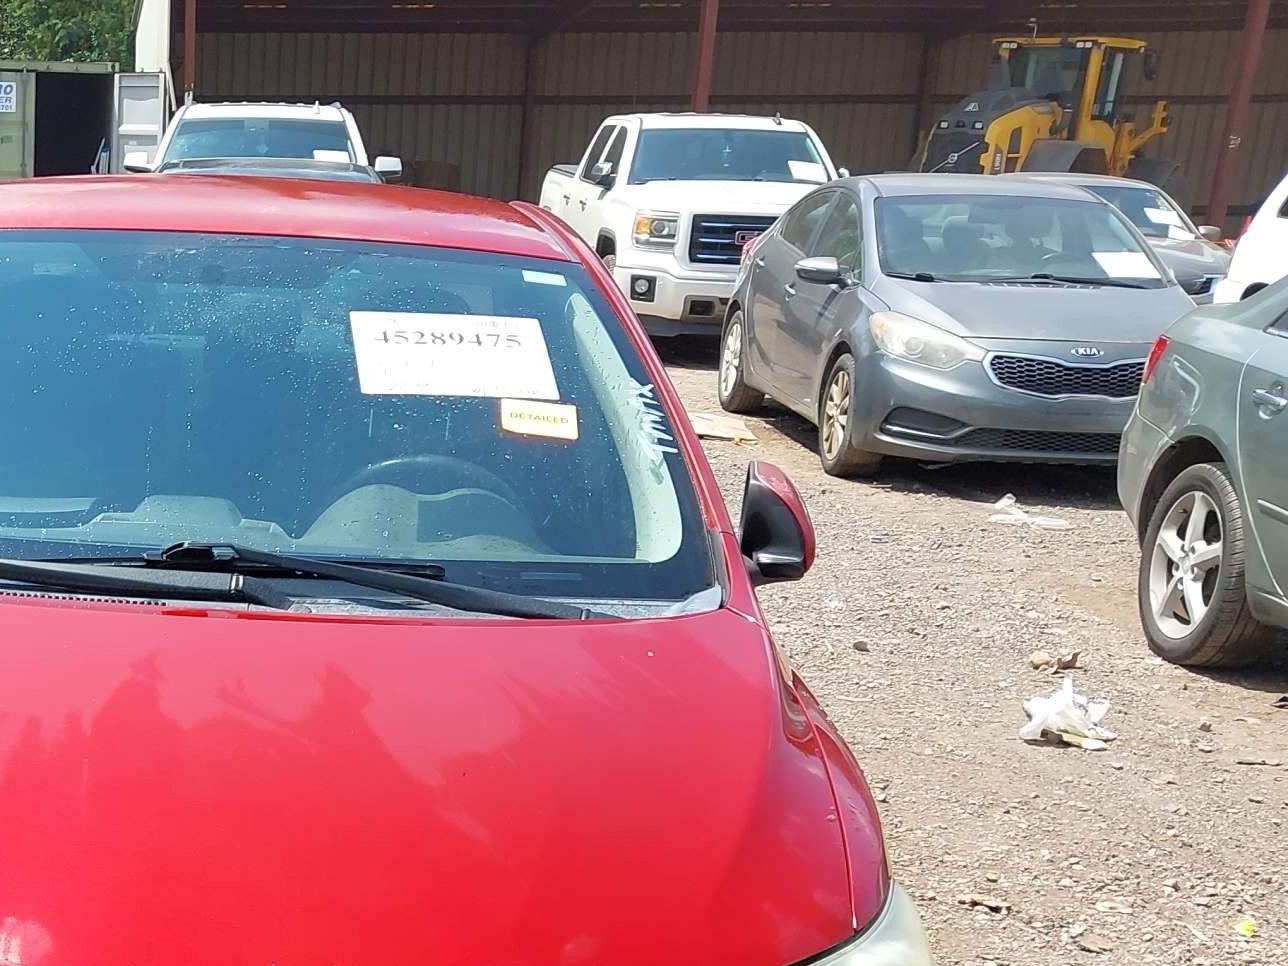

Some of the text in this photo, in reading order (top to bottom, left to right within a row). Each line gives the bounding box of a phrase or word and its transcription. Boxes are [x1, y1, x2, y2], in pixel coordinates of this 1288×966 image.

[374, 330, 522, 348] 45289475
[1078, 347, 1099, 355] KIA
[509, 411, 570, 425] DETAILED
